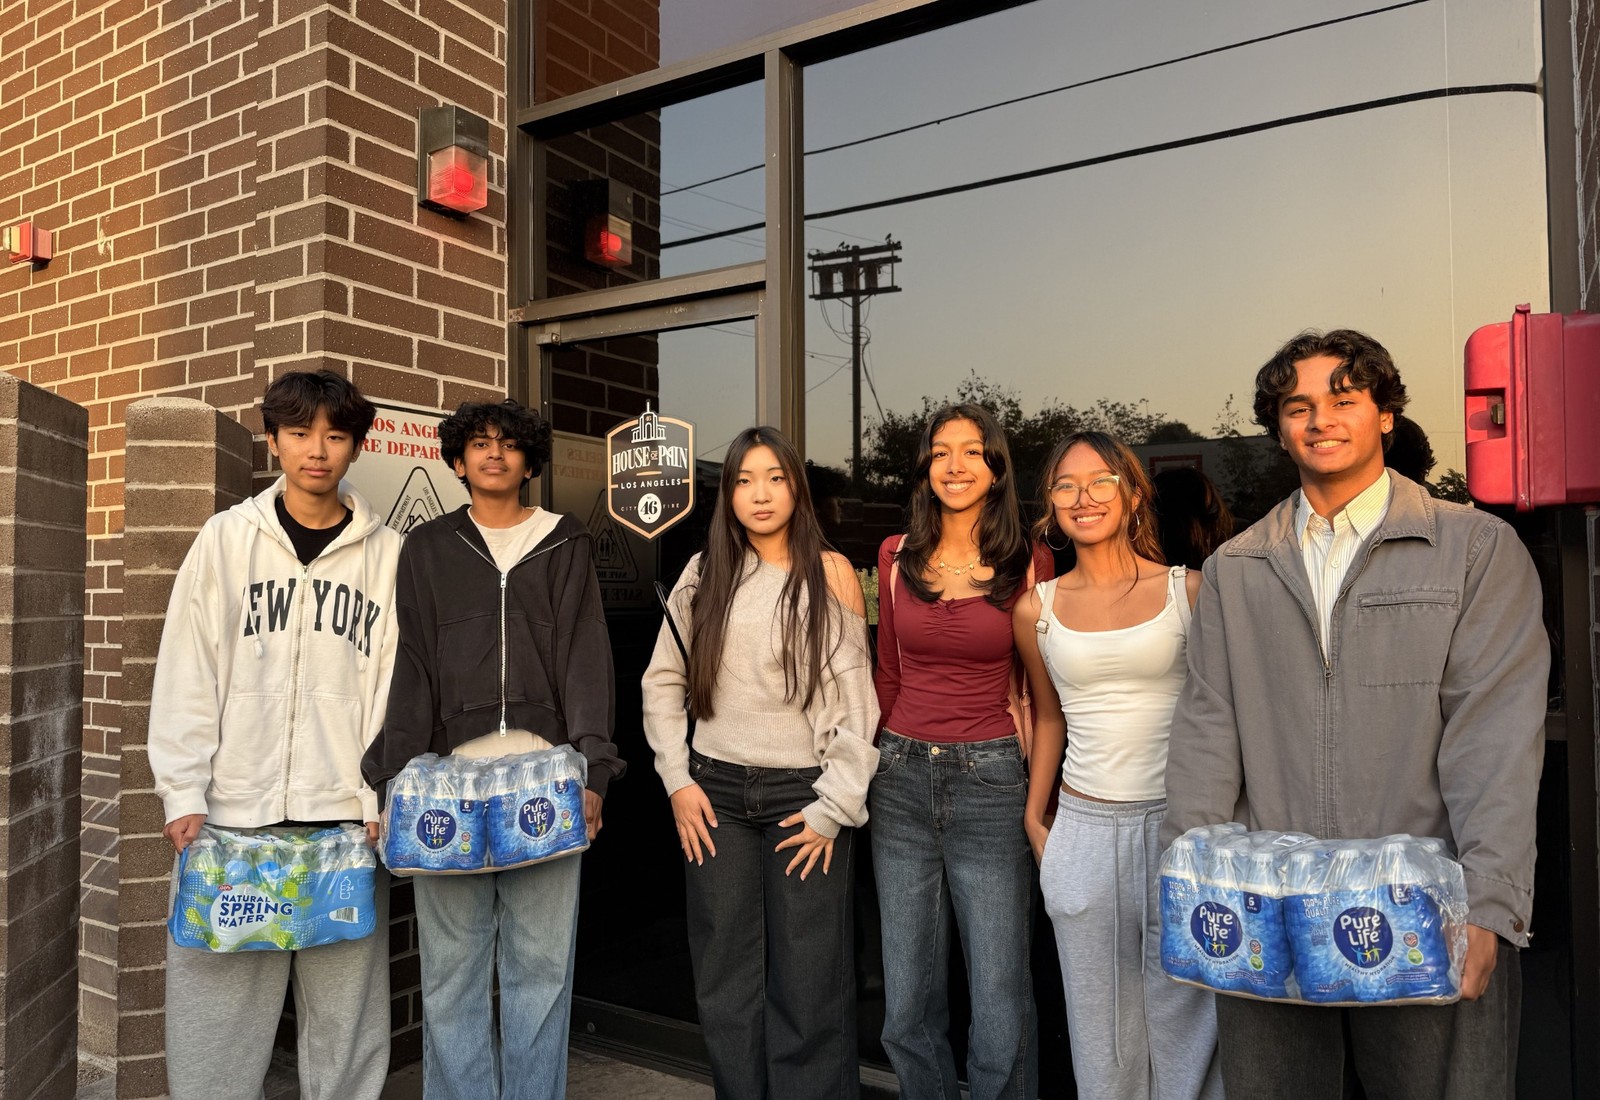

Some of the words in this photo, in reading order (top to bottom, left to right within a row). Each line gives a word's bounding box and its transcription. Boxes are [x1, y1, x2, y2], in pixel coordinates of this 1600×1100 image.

[369, 417, 396, 433] OS
[361, 438, 382, 453] RE
[387, 440, 441, 460] DEPAR
[612, 446, 650, 475] HOUSE
[658, 445, 688, 470] PAIN
[620, 481, 637, 490] LOS
[640, 478, 681, 488] ANGELES
[640, 500, 658, 515] 46
[242, 578, 297, 637] EW
[313, 579, 381, 658] YORK
[523, 801, 549, 815] Pure
[424, 812, 450, 825] Pure
[527, 812, 547, 825] Life
[425, 824, 446, 837] Life
[221, 894, 271, 903] NATURAL
[1396, 888, 1405, 898] 6
[1248, 896, 1255, 907] 6
[219, 902, 293, 917] SPRING
[1199, 905, 1233, 926] Pure
[1340, 914, 1381, 930] Pure
[1202, 921, 1229, 942] Life
[1348, 928, 1380, 949] Life
[1344, 962, 1368, 976] HEALTHY
[1369, 955, 1395, 976] HYDRATION
